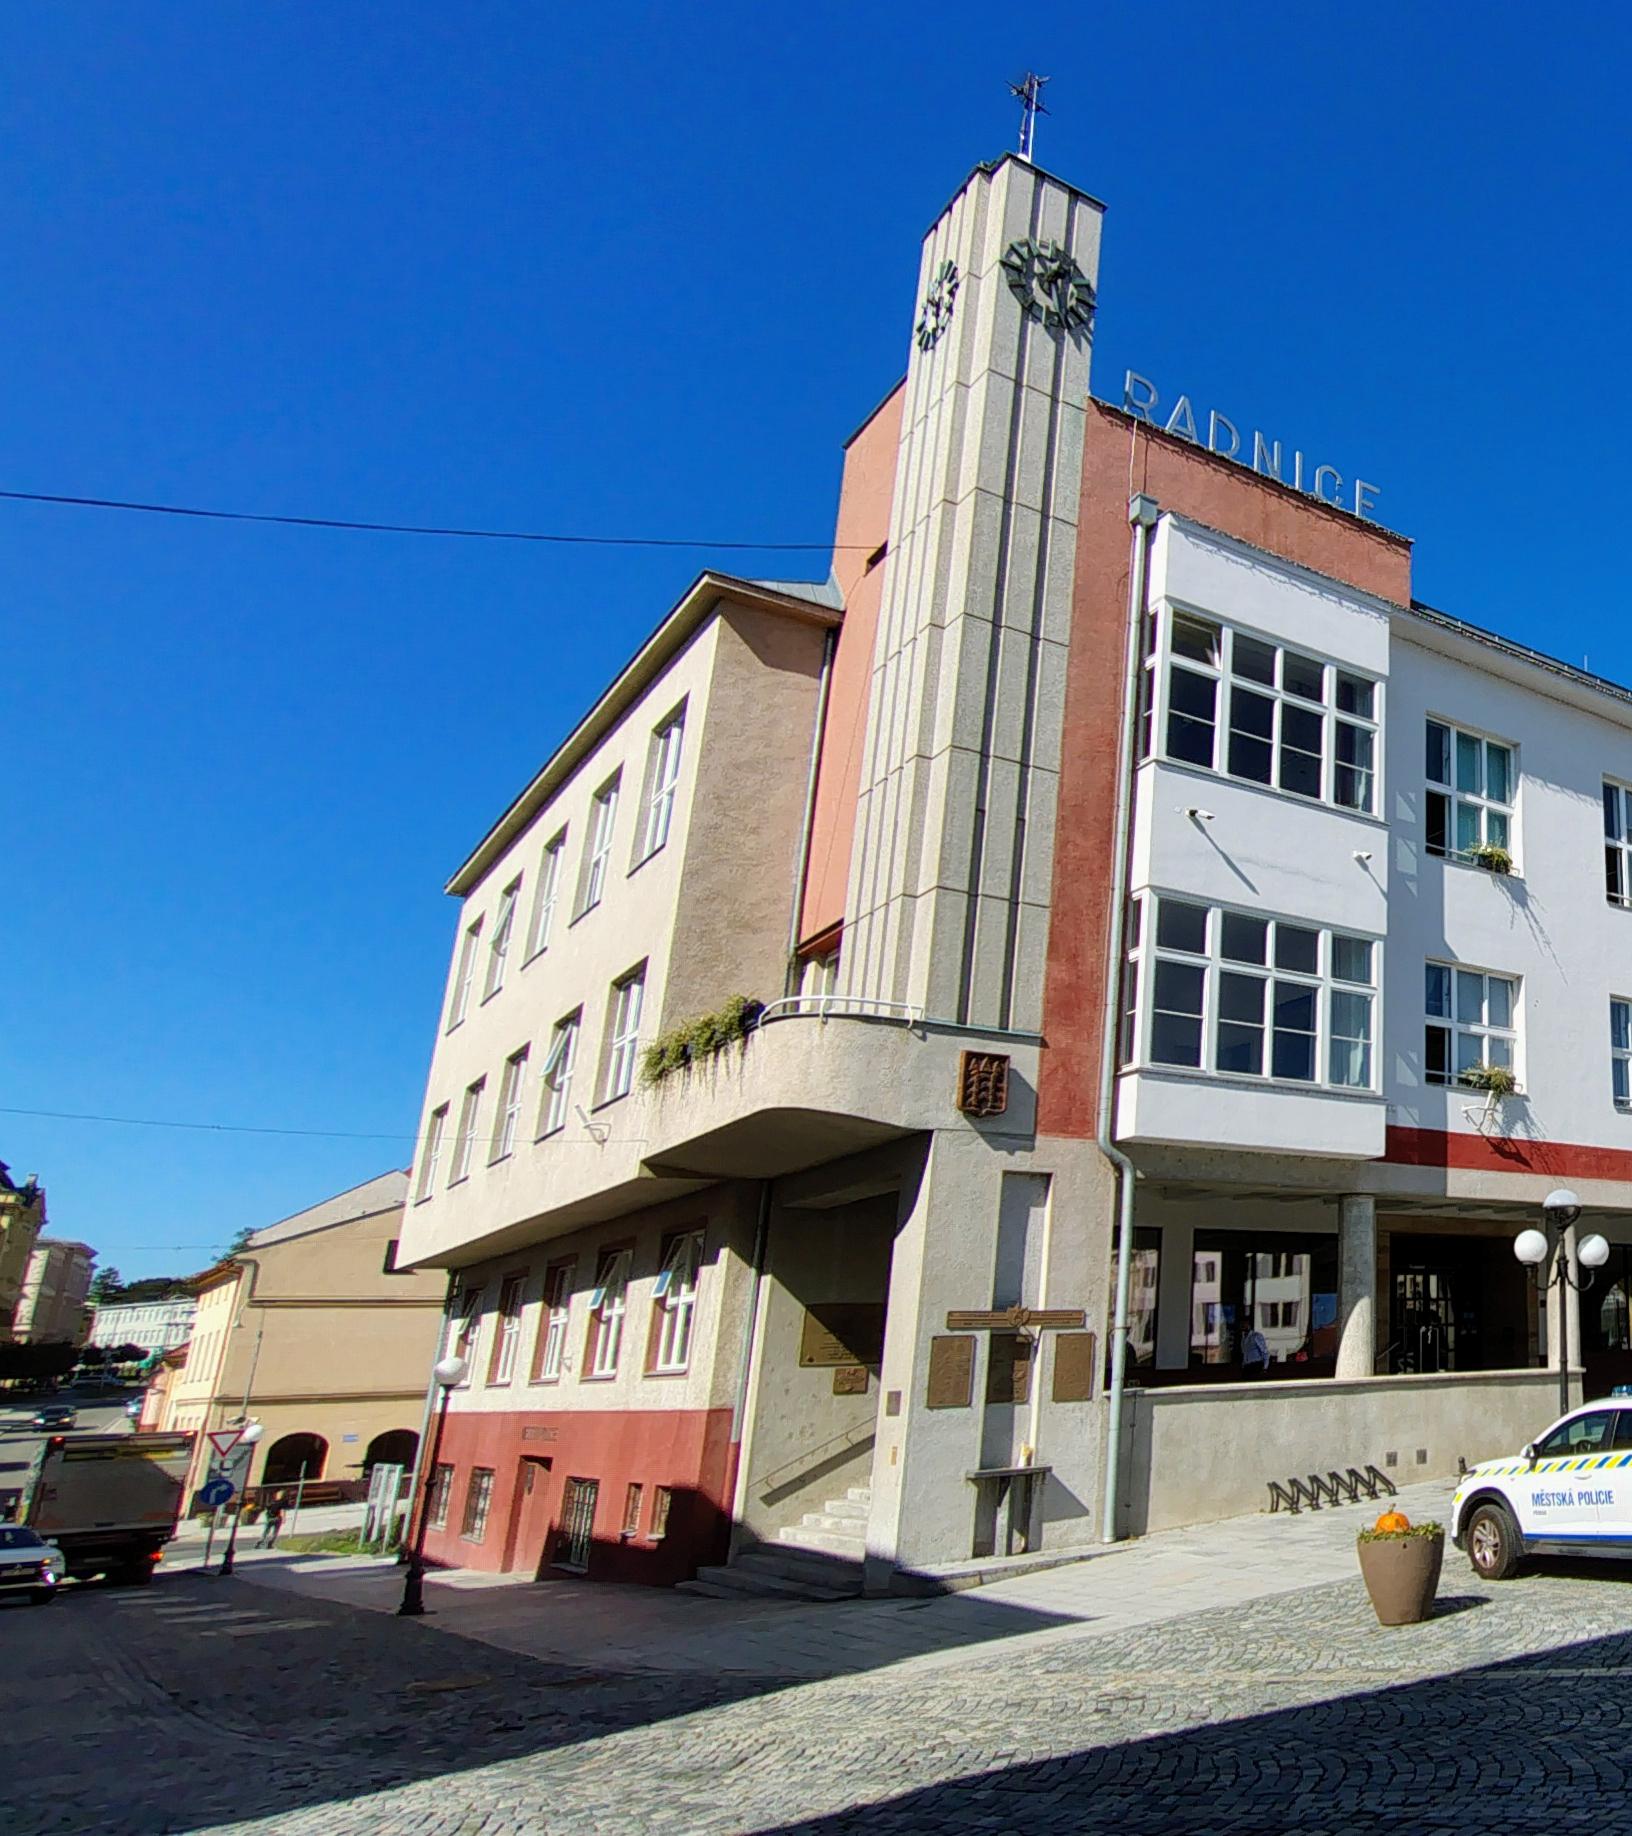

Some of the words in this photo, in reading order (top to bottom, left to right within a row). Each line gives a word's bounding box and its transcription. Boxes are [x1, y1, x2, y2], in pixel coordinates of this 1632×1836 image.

[1123, 368, 1382, 518] RADNICE
[1531, 1488, 1575, 1507] MĚSTSKÁ
[1577, 1490, 1615, 1506] POLICIE
